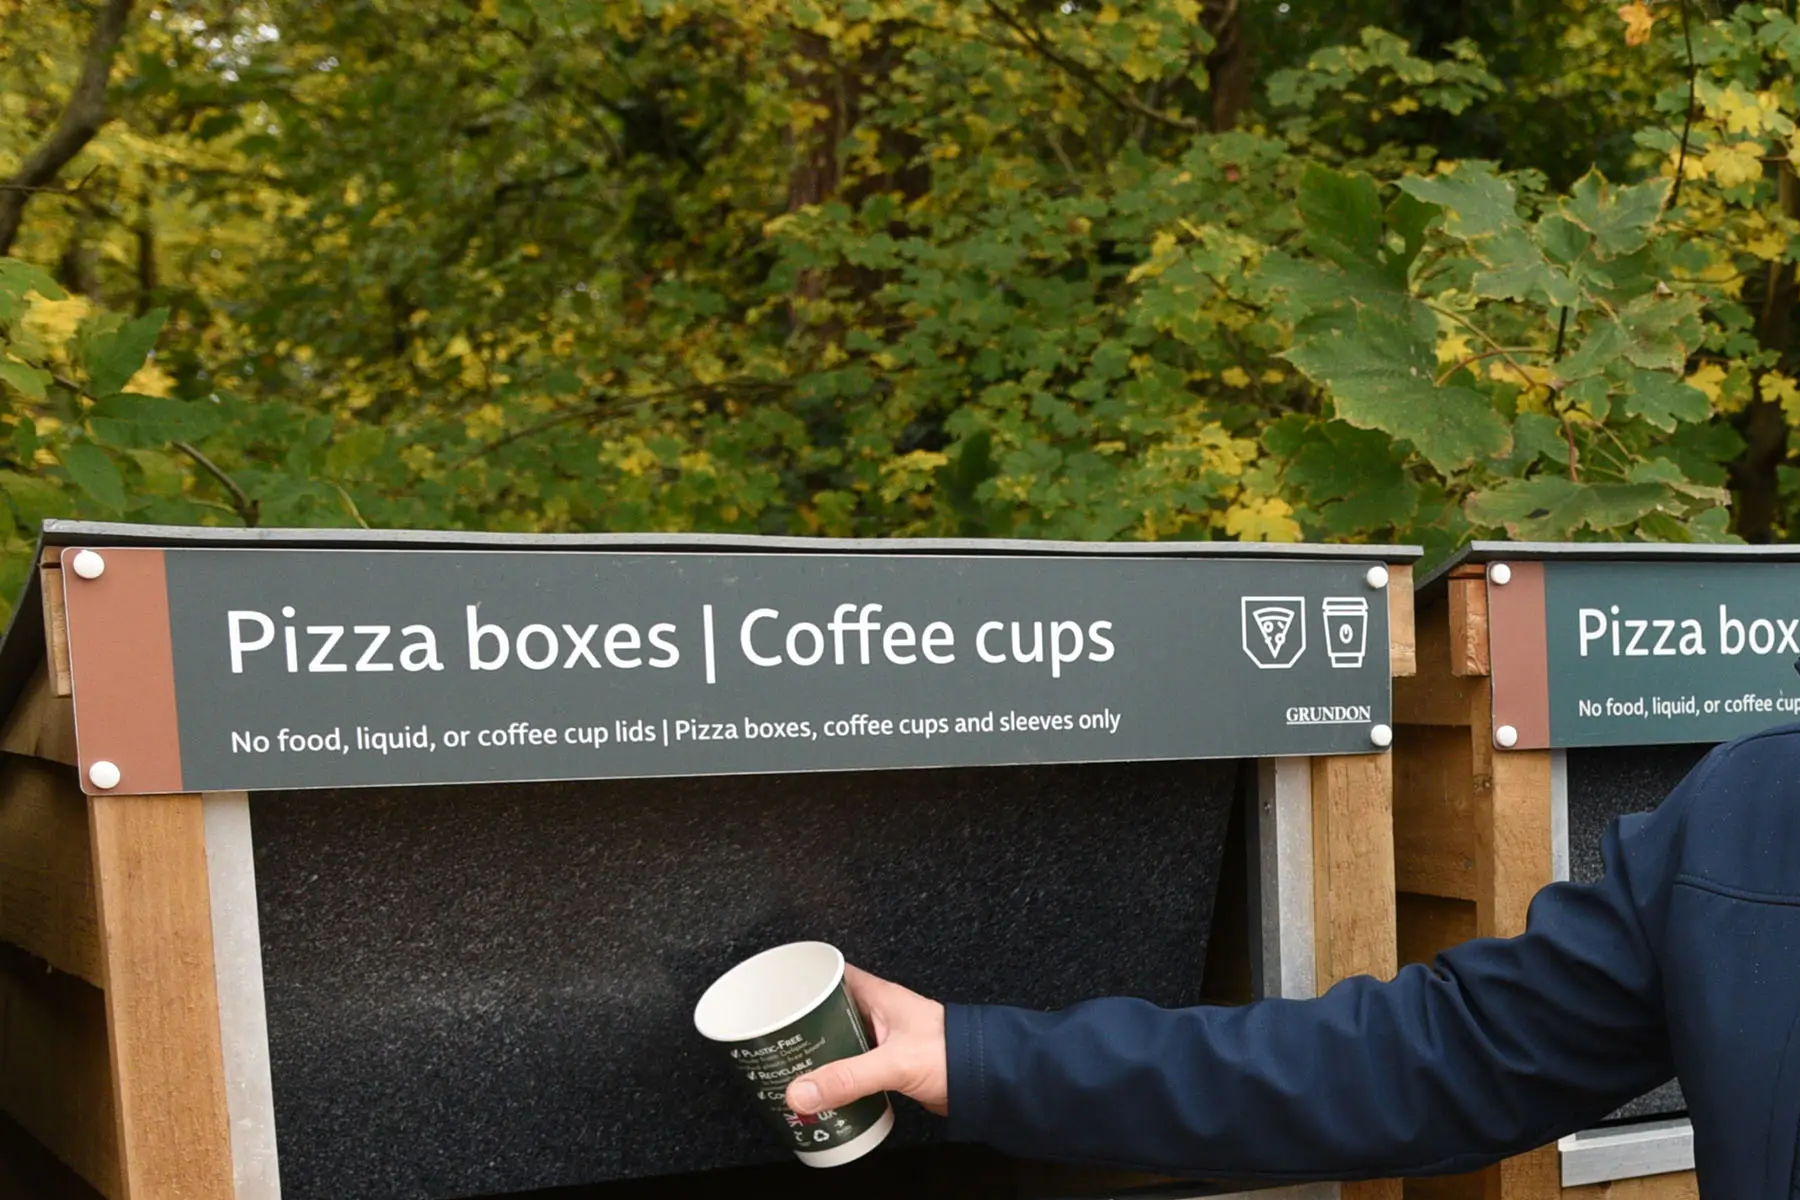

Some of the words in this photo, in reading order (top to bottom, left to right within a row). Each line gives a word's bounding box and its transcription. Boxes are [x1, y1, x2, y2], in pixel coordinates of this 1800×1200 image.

[228, 605, 445, 674] Pizza
[466, 603, 680, 671] boxes
[740, 603, 955, 667] Coffee
[976, 619, 1116, 679] cups
[1578, 604, 1707, 657] Pizza
[1286, 705, 1371, 723] GRUNDON
[1579, 700, 1602, 717] No
[1606, 697, 1649, 719] food,
[1652, 695, 1700, 719] liquid,
[1704, 700, 1721, 714] or
[1724, 694, 1773, 713] coffee
[231, 730, 270, 754] No
[277, 728, 350, 755] food,
[356, 725, 436, 755] liquid,
[444, 731, 471, 748] or
[478, 722, 558, 747] coffee
[565, 727, 609, 749] cup
[615, 719, 657, 743] lids
[675, 718, 739, 741] Pizza
[744, 716, 818, 741] boxes,
[823, 713, 894, 737] coffee
[899, 716, 950, 739] cups
[955, 711, 994, 733] and
[999, 710, 1074, 732] sleeves
[1079, 708, 1121, 734] only
